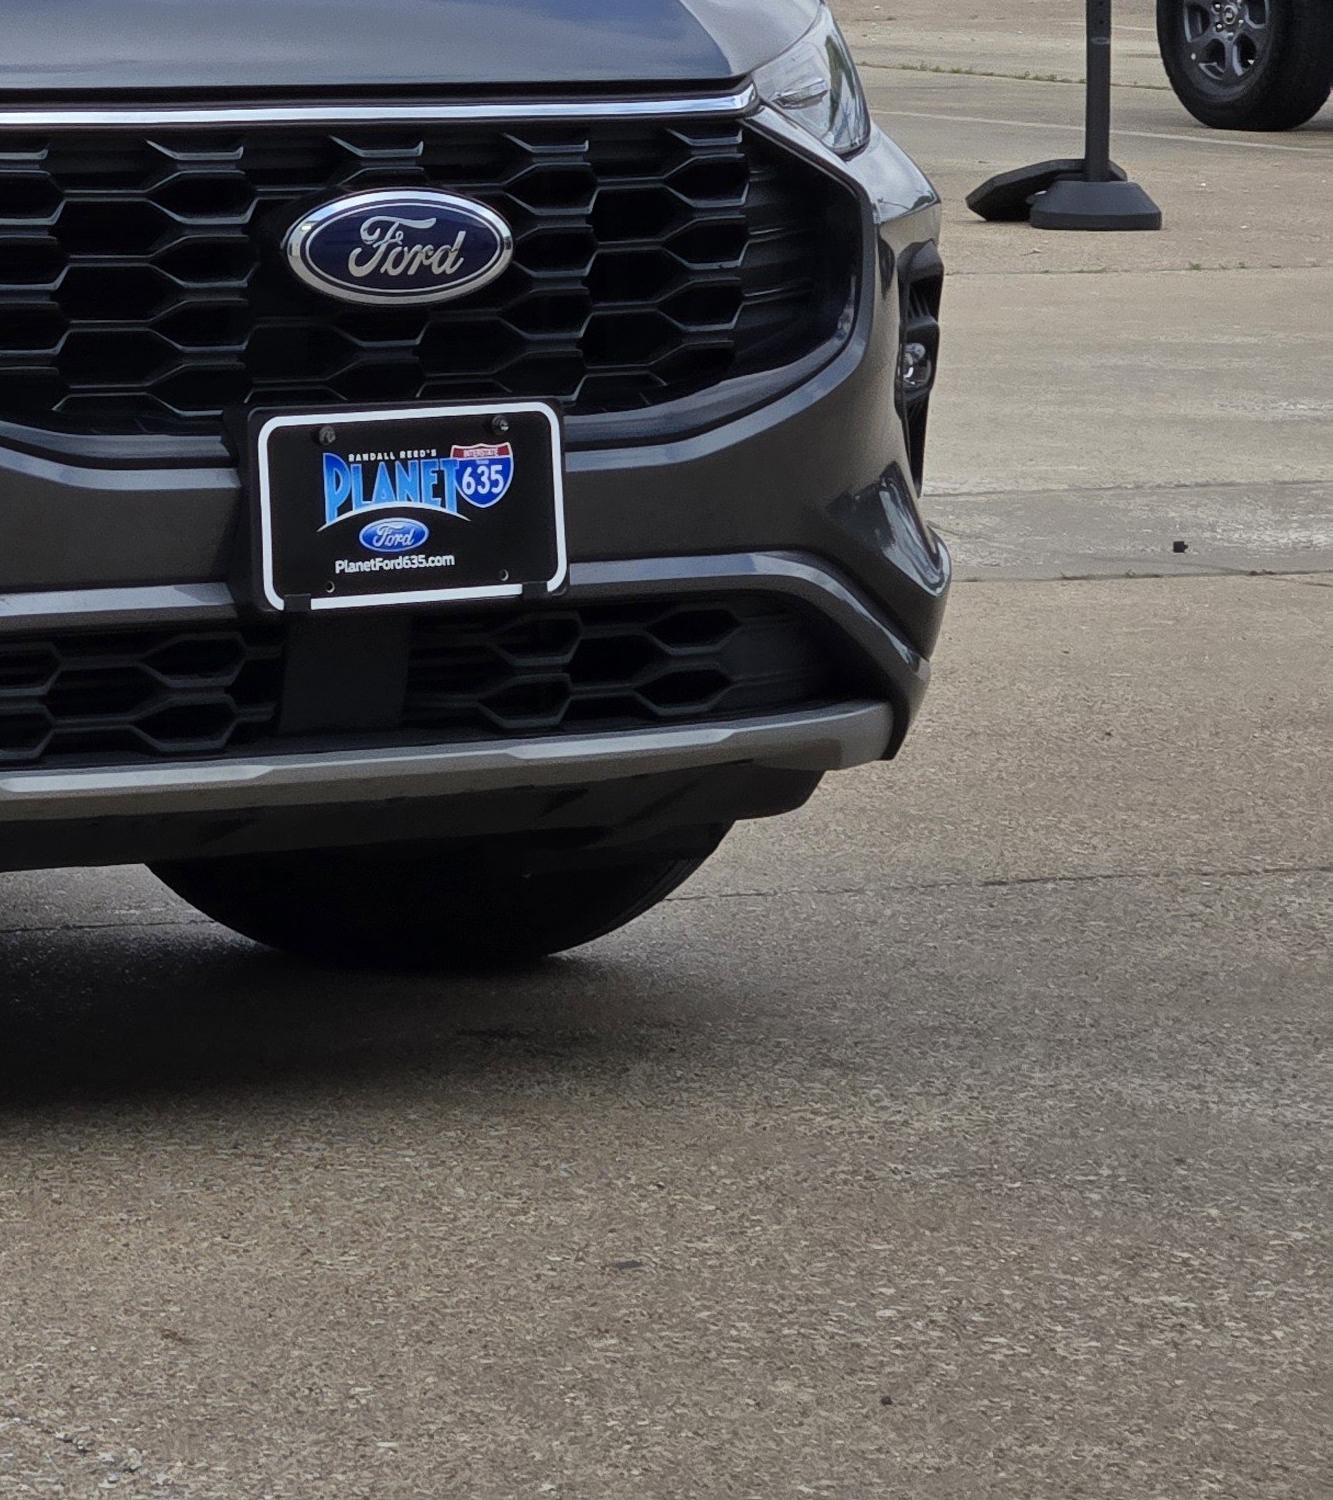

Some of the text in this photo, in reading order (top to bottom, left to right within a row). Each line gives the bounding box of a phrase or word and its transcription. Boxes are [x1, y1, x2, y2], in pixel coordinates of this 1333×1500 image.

[348, 215, 467, 278] Ford
[348, 451, 395, 462] RANDALL
[323, 452, 460, 523] PLANET
[461, 464, 504, 496] 635
[373, 521, 415, 547] Ford
[335, 554, 455, 574] PlanetFord635.com
